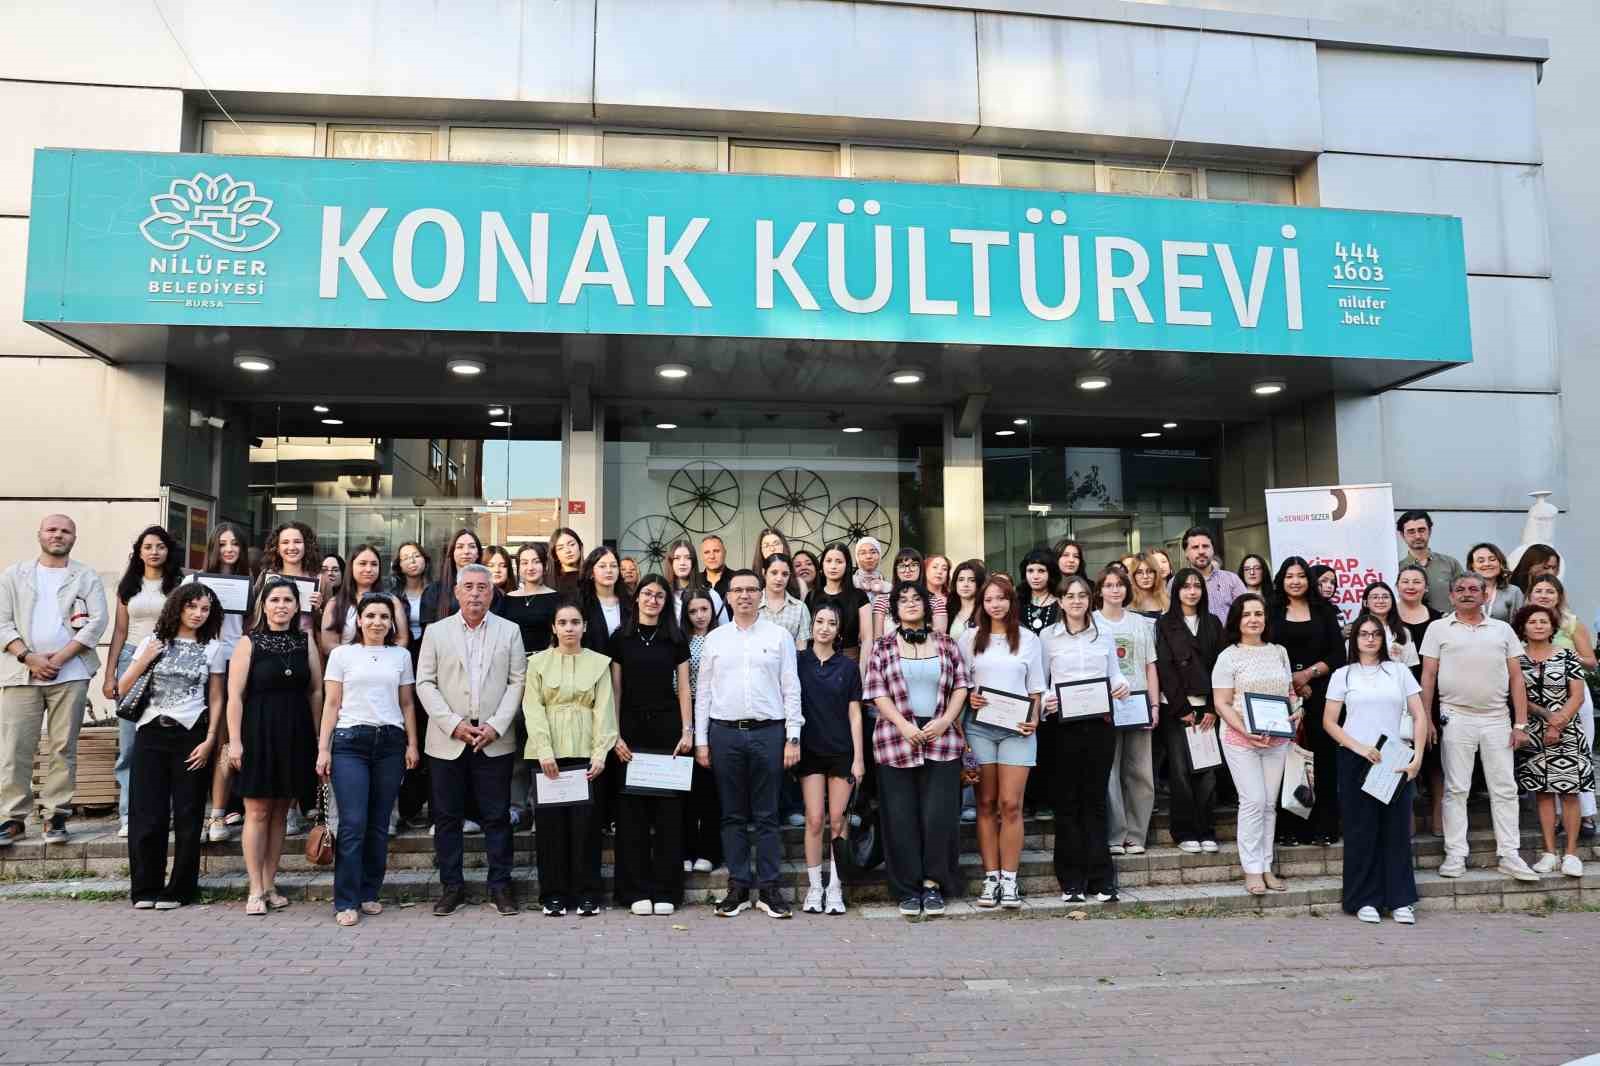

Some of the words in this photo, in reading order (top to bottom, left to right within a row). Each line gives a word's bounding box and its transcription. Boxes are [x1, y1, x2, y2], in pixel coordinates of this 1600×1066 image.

[1335, 241, 1380, 264] 444
[149, 254, 267, 276] NİLÜFER
[319, 205, 713, 308] KONAK
[755, 198, 1304, 331] KÜLTÜREVİ
[1333, 261, 1385, 282] 1603
[148, 279, 265, 295] BELEDİYESİ
[185, 299, 225, 308] BURSA
[1338, 295, 1387, 309] nilufer
[1340, 311, 1382, 325] .bel.tr
